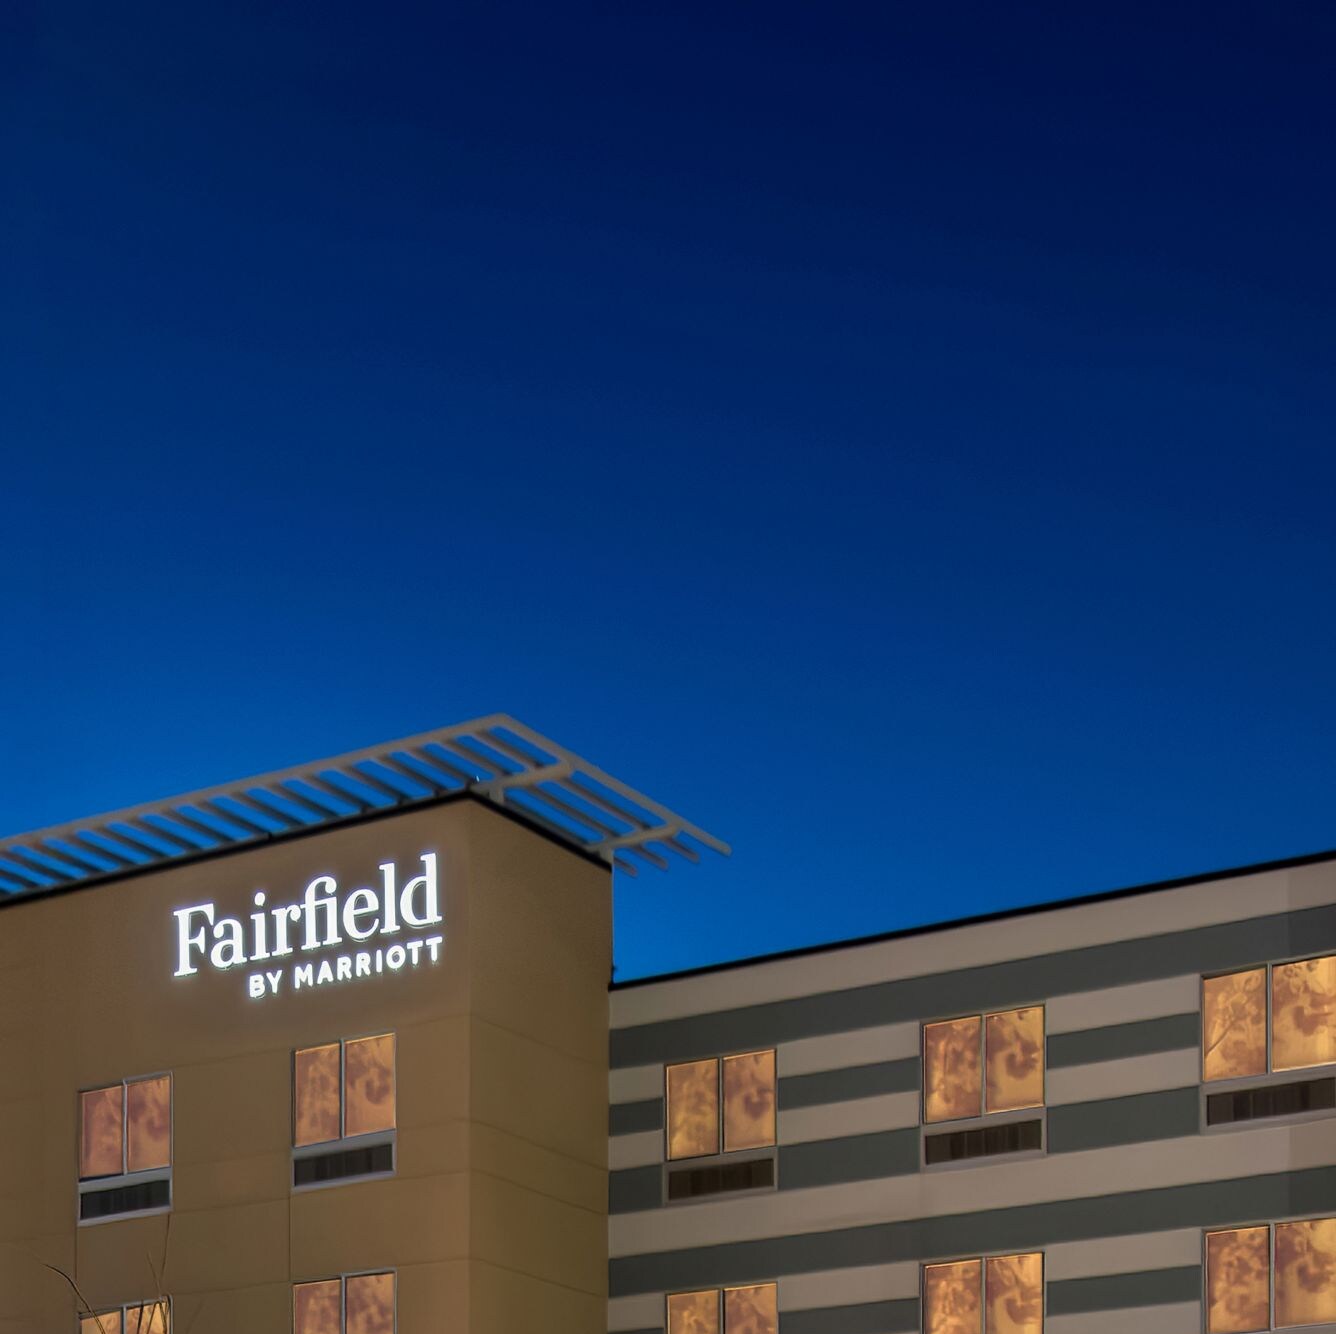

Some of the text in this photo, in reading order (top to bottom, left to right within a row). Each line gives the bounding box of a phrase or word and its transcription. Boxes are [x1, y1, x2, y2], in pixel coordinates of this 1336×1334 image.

[173, 853, 443, 977] Fairfield
[249, 936, 443, 999] BY MARRIOTT
